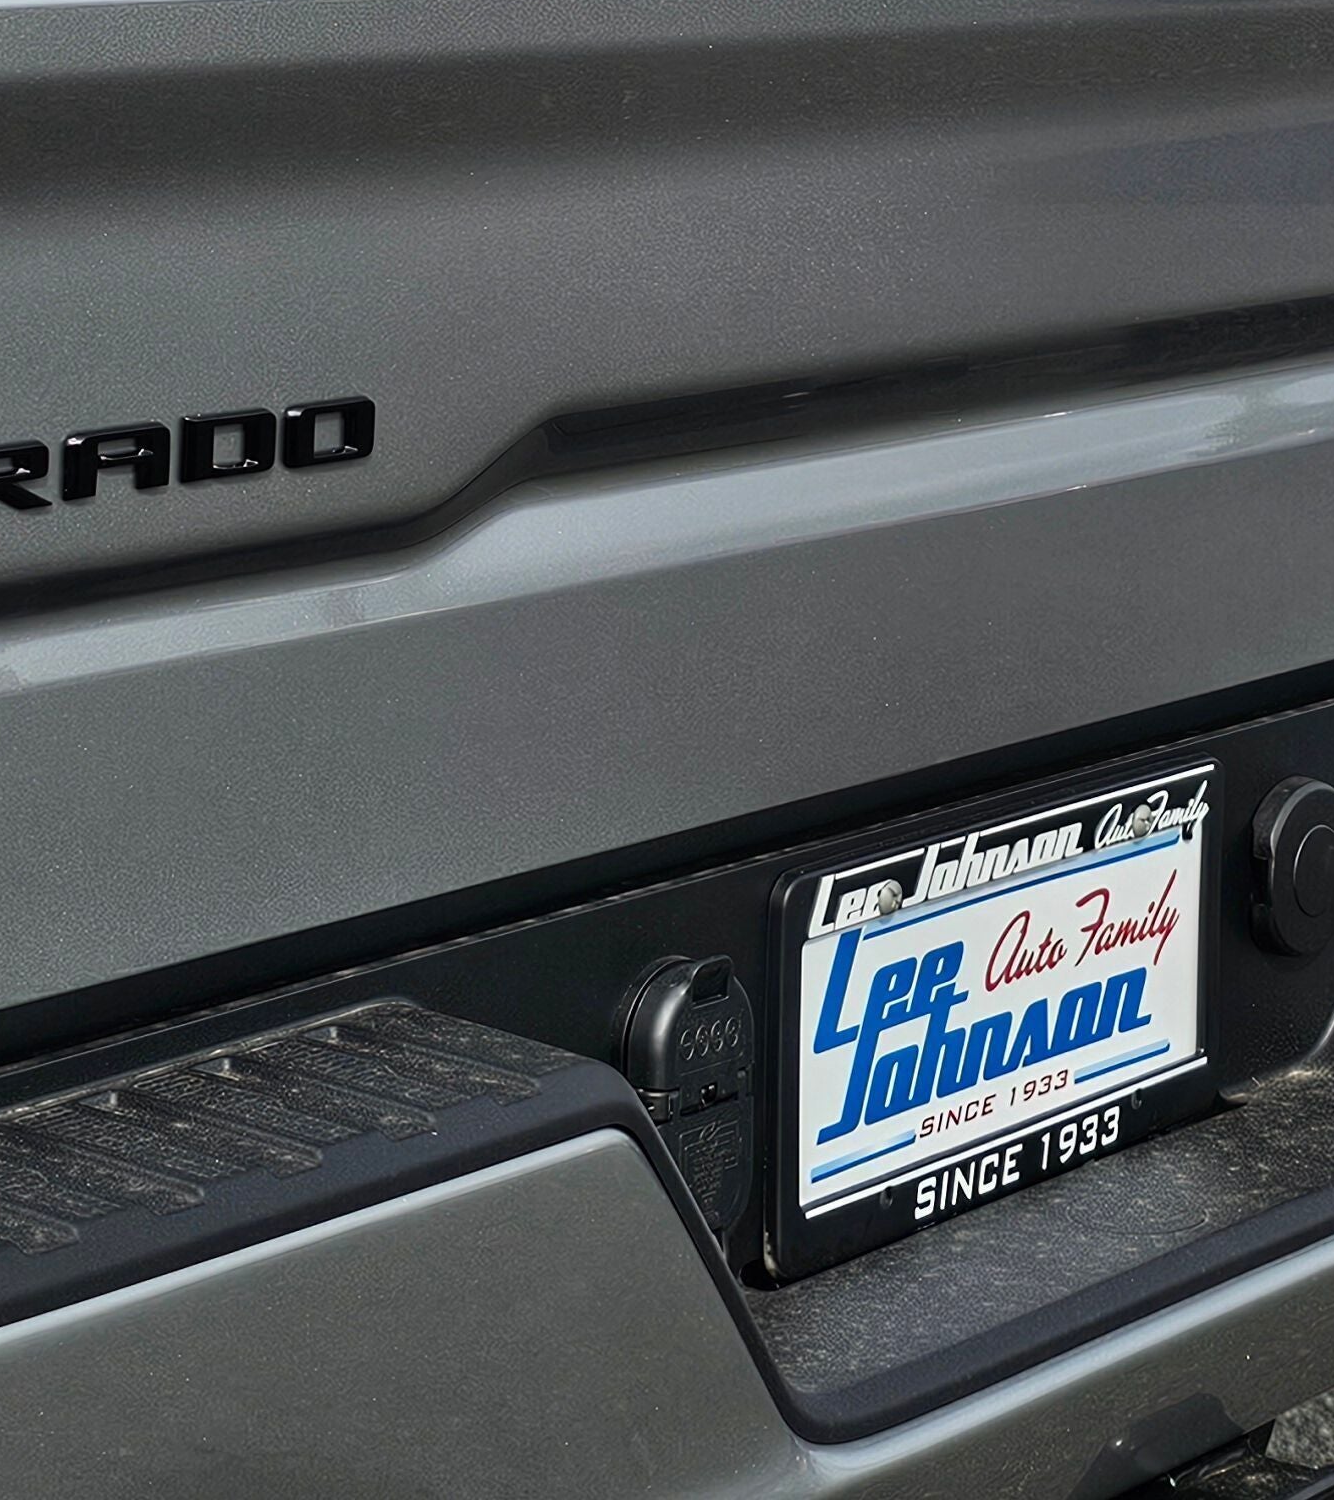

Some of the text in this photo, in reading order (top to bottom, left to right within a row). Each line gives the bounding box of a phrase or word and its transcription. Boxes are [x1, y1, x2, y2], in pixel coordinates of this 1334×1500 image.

[902, 822, 1083, 908] Johnson
[1094, 803, 1140, 849] Aut
[1147, 780, 1209, 837] Family
[813, 928, 966, 1054] Lee
[984, 869, 1179, 992] Auto Family
[817, 967, 1151, 1146] Johnson
[919, 1068, 1069, 1139] SINCE 1933
[914, 1106, 1120, 1220] SINCE 1933
